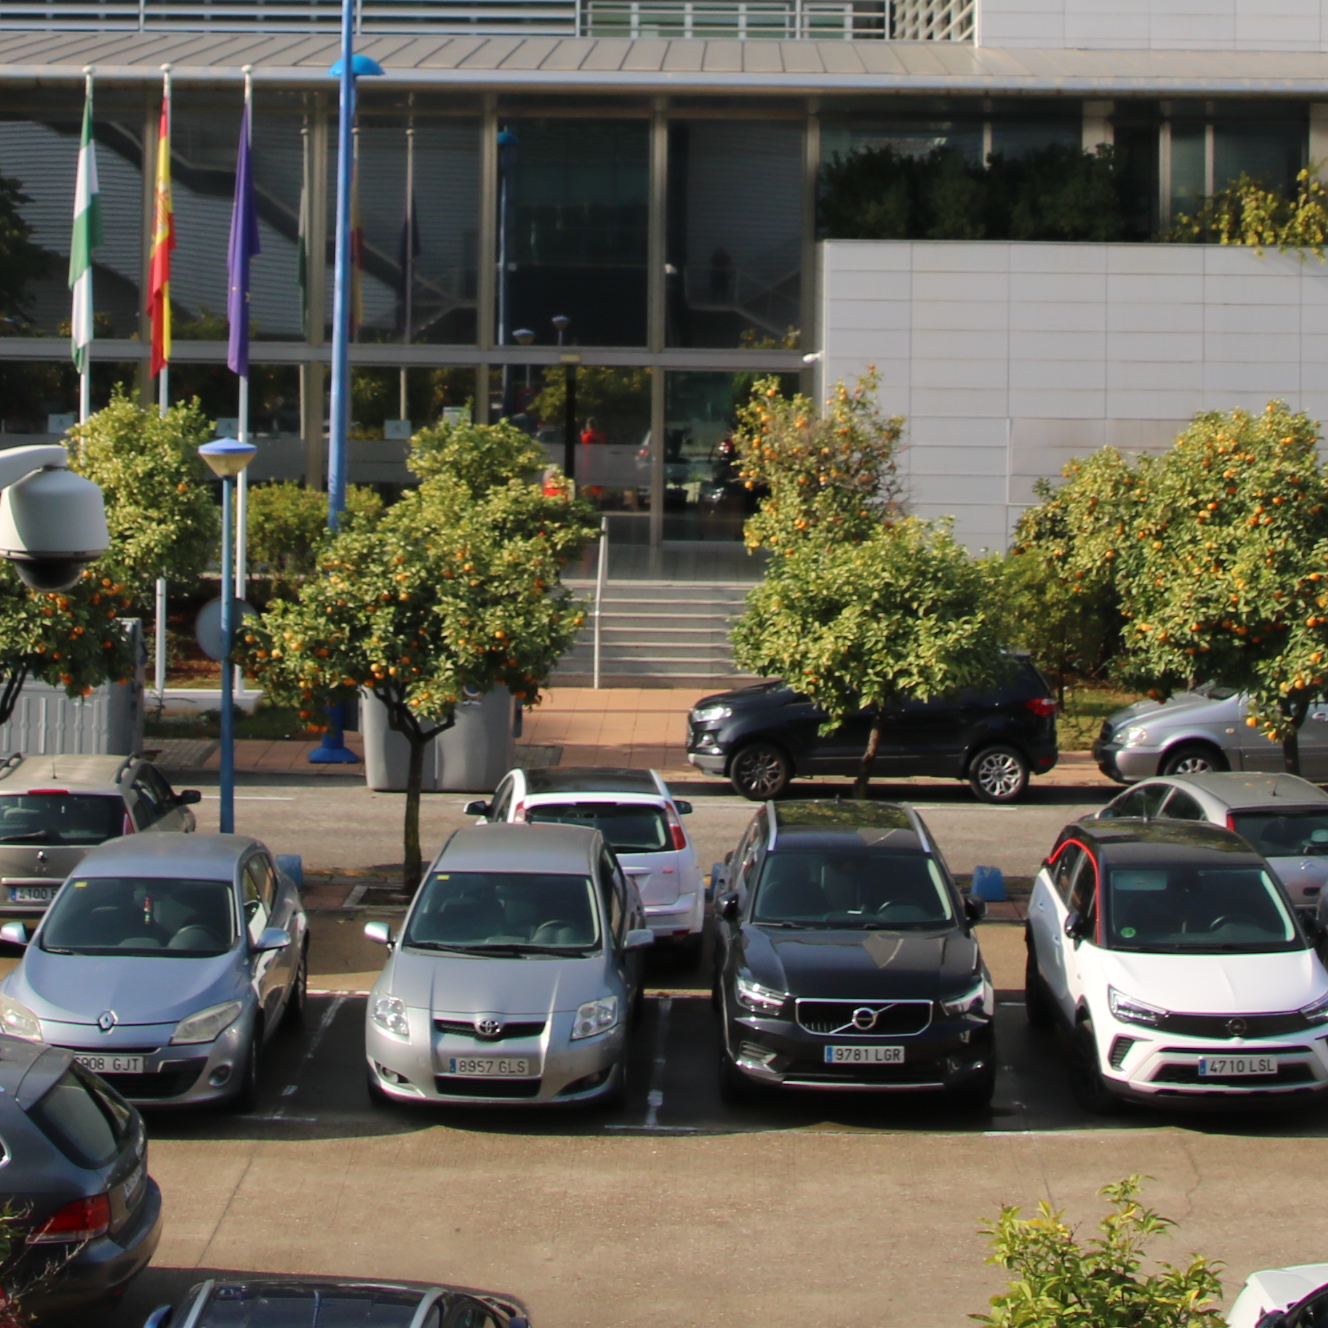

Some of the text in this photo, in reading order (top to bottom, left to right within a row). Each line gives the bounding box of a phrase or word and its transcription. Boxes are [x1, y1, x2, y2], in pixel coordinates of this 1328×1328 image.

[836, 1048, 901, 1062] 9781 LGR
[113, 1058, 140, 1071] GJT
[459, 1060, 526, 1074] 8957 GLS
[1210, 1058, 1275, 1073] 4710 LSL
